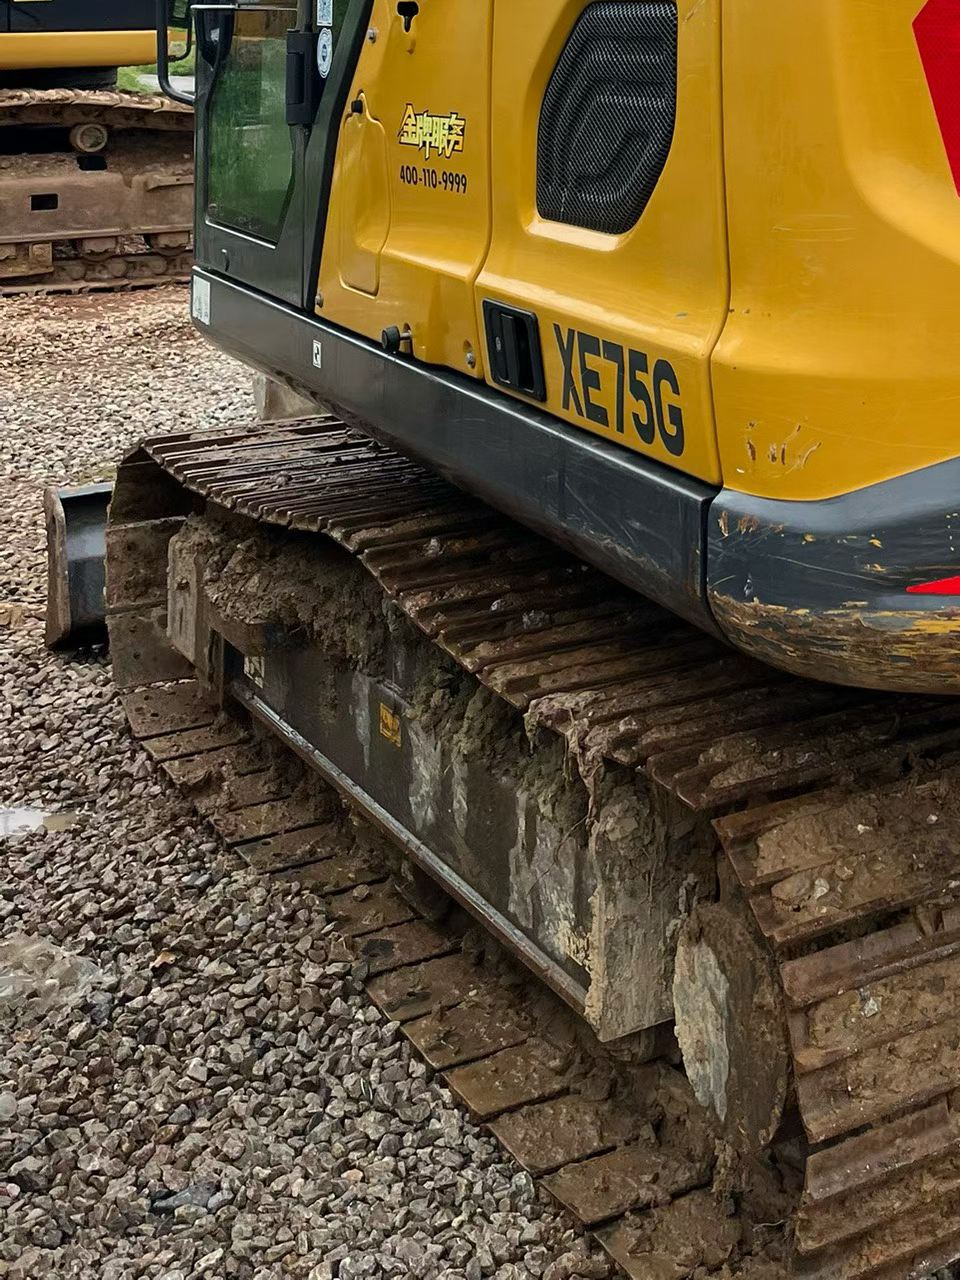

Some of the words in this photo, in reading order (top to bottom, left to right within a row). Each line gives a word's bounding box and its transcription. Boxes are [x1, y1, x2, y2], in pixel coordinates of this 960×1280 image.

[397, 103, 466, 161] 金牌服务
[400, 165, 467, 194] 400-110-9999
[552, 322, 685, 457] XE75G
